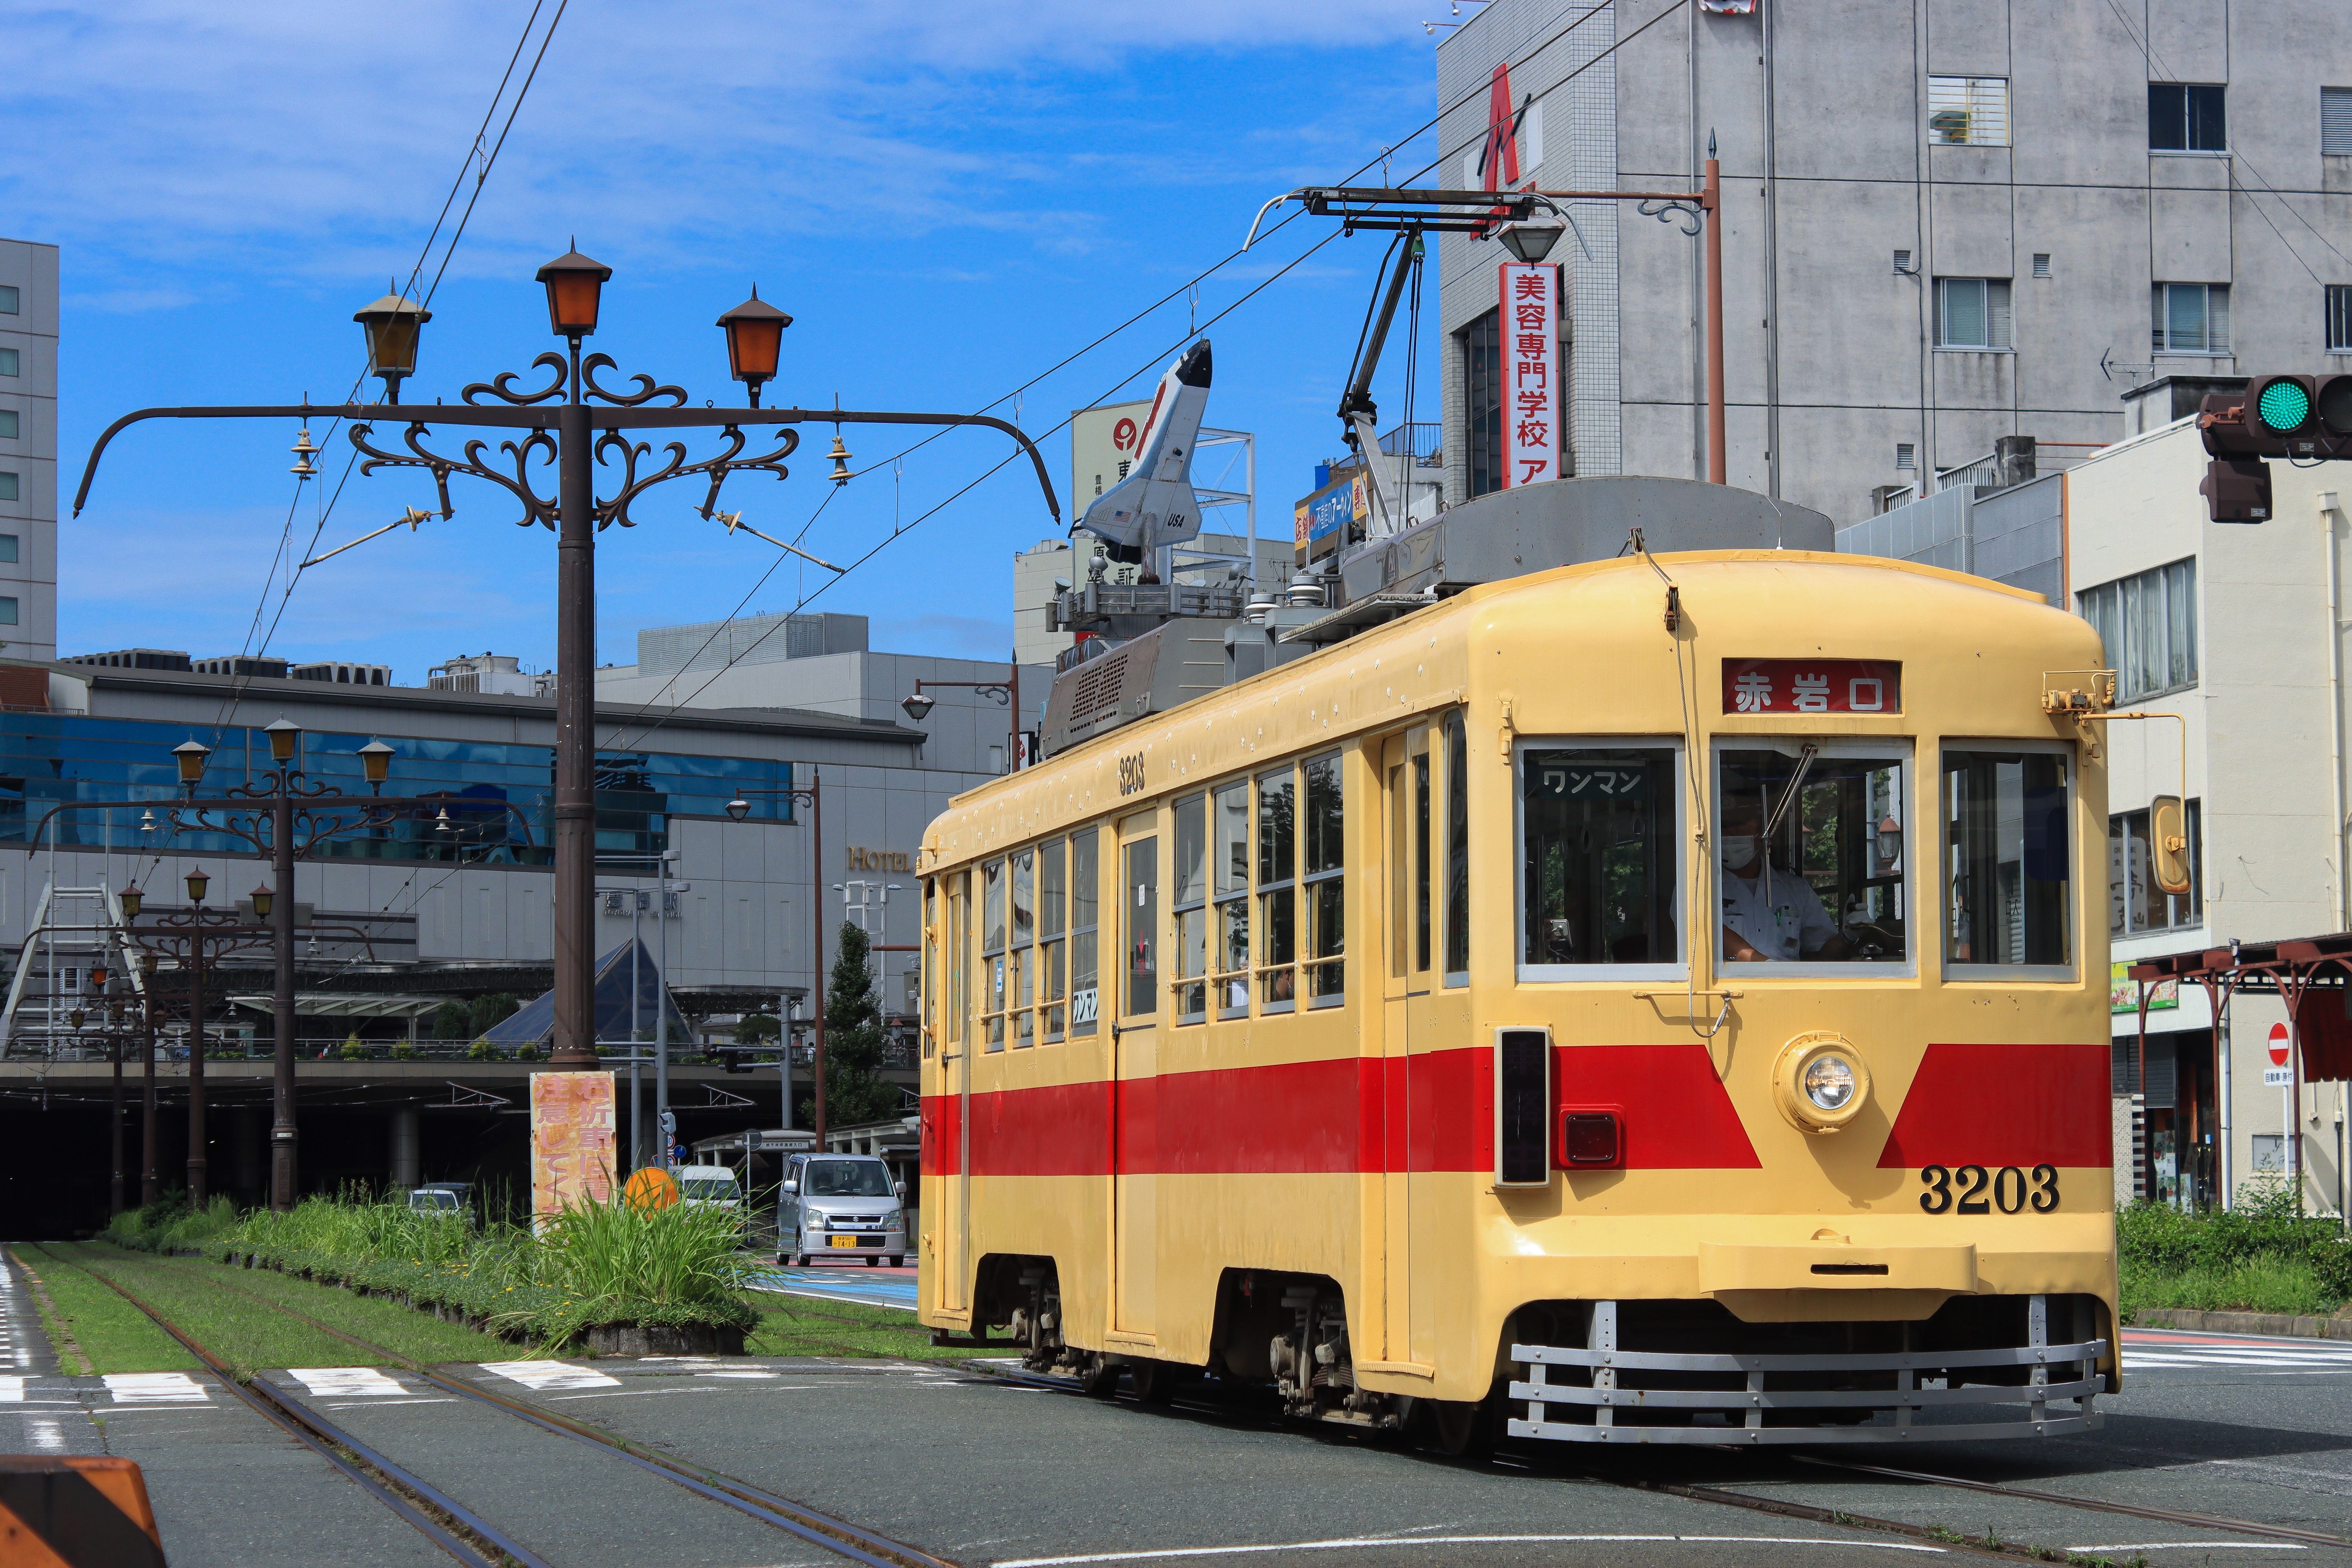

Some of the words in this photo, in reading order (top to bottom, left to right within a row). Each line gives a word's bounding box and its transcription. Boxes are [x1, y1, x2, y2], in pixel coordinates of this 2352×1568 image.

[1515, 274, 1548, 448] 美容専門学校
[1519, 459, 1547, 485] ア
[1167, 513, 1185, 529] USA
[1735, 671, 1883, 712] 赤岩口
[1120, 750, 1145, 797] 3203
[1544, 771, 1641, 794] ワンマン
[848, 846, 915, 871] HOTEL
[1919, 1163, 2060, 1215] 3203
